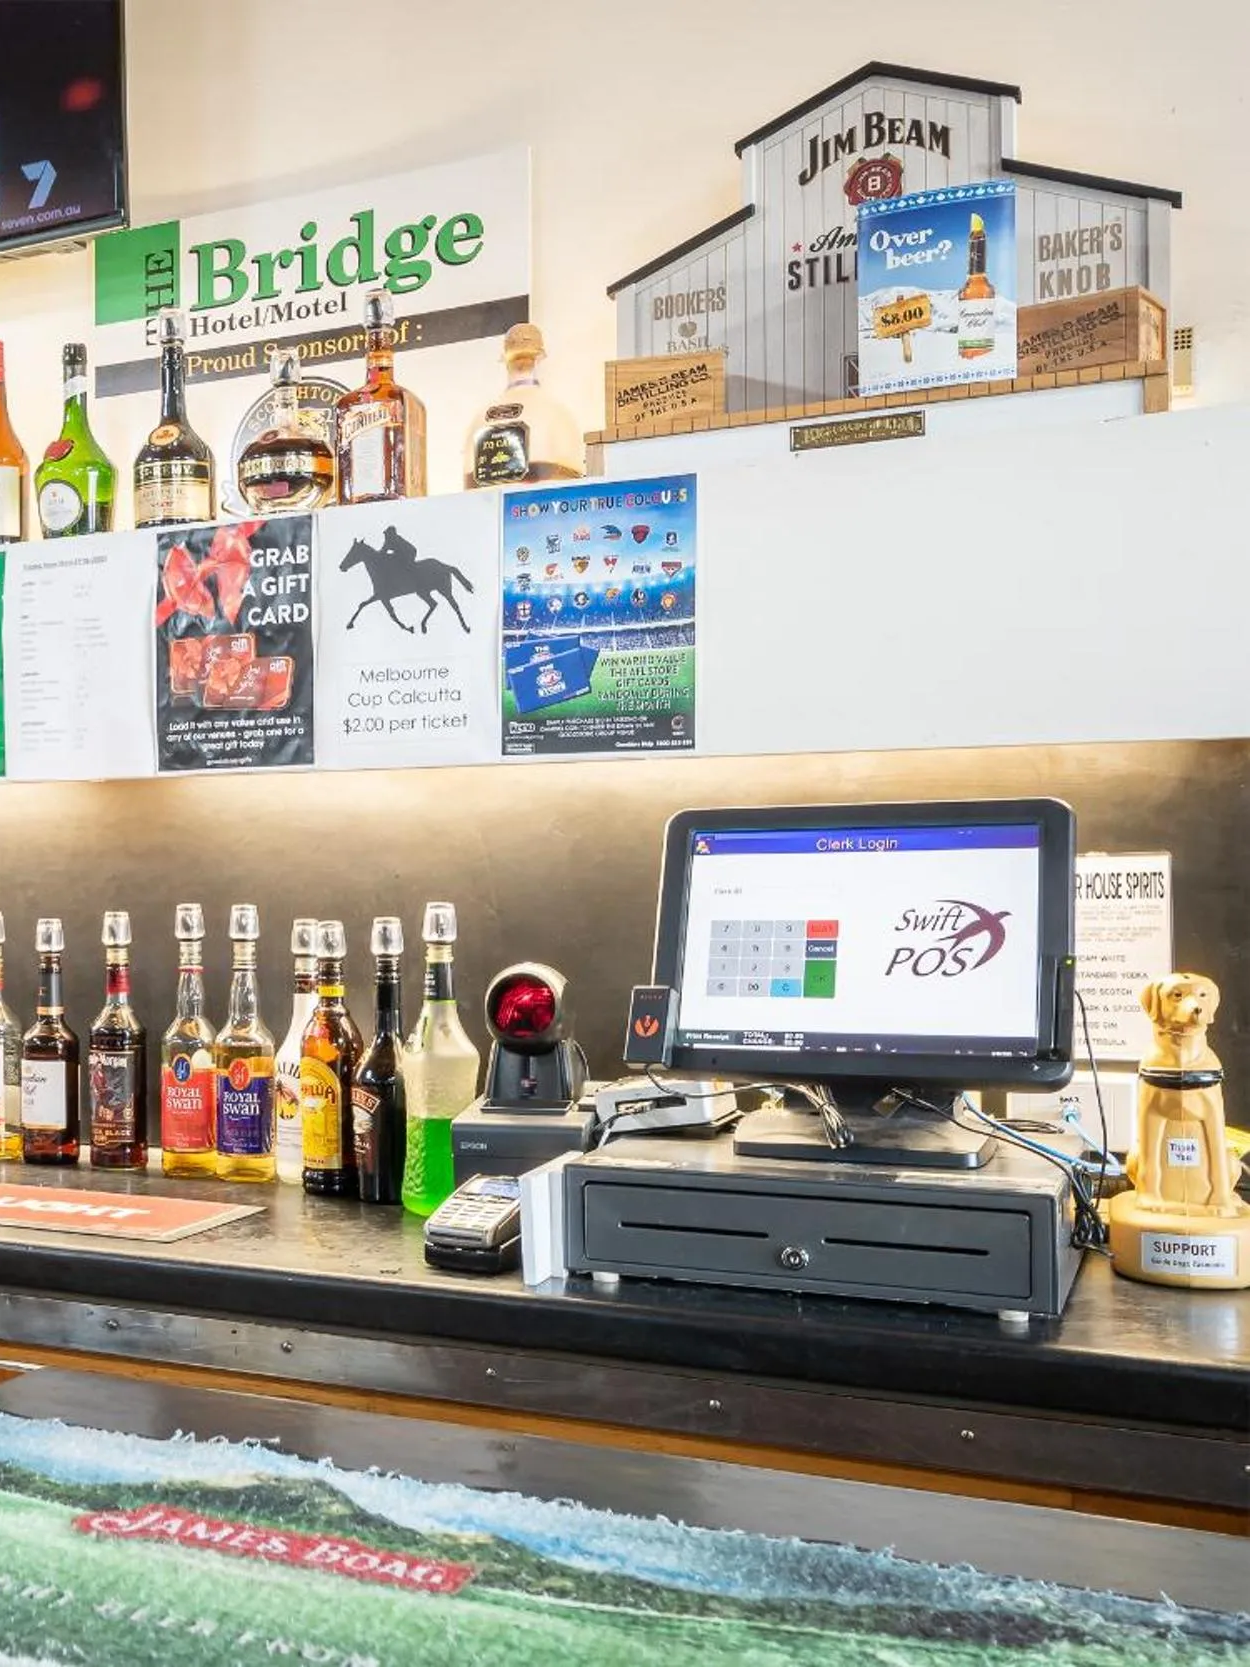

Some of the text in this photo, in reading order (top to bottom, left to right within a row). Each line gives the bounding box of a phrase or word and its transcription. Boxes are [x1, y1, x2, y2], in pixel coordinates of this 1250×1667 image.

[799, 111, 951, 186] JIM BEAM
[0, 204, 82, 230] seven.com.au
[869, 226, 934, 252] Over
[1039, 223, 1123, 262] BAKER'S
[189, 208, 485, 311] Bridge
[885, 238, 954, 270] beer?
[1040, 263, 1111, 299] KNOB
[190, 291, 348, 339] Hotel/Motel
[880, 305, 924, 329] $8.00
[186, 344, 256, 378] Proud
[512, 503, 549, 518] SHOW
[551, 499, 589, 515] YOUR
[249, 545, 310, 566] GRAB
[261, 573, 310, 597] GIFT
[247, 609, 310, 627] CARD
[359, 664, 450, 684] Melbourne
[347, 687, 462, 709] Cup Calcutta
[342, 711, 469, 736] $2.00 per ticket
[815, 836, 899, 852] Clerk Login
[1086, 871, 1165, 900] HOUSE SPIRITS
[894, 904, 967, 931] Swift
[884, 946, 975, 977] POS
[1152, 1240, 1218, 1257] SUPPORT
[89, 1509, 448, 1585] JAMES BOAG
